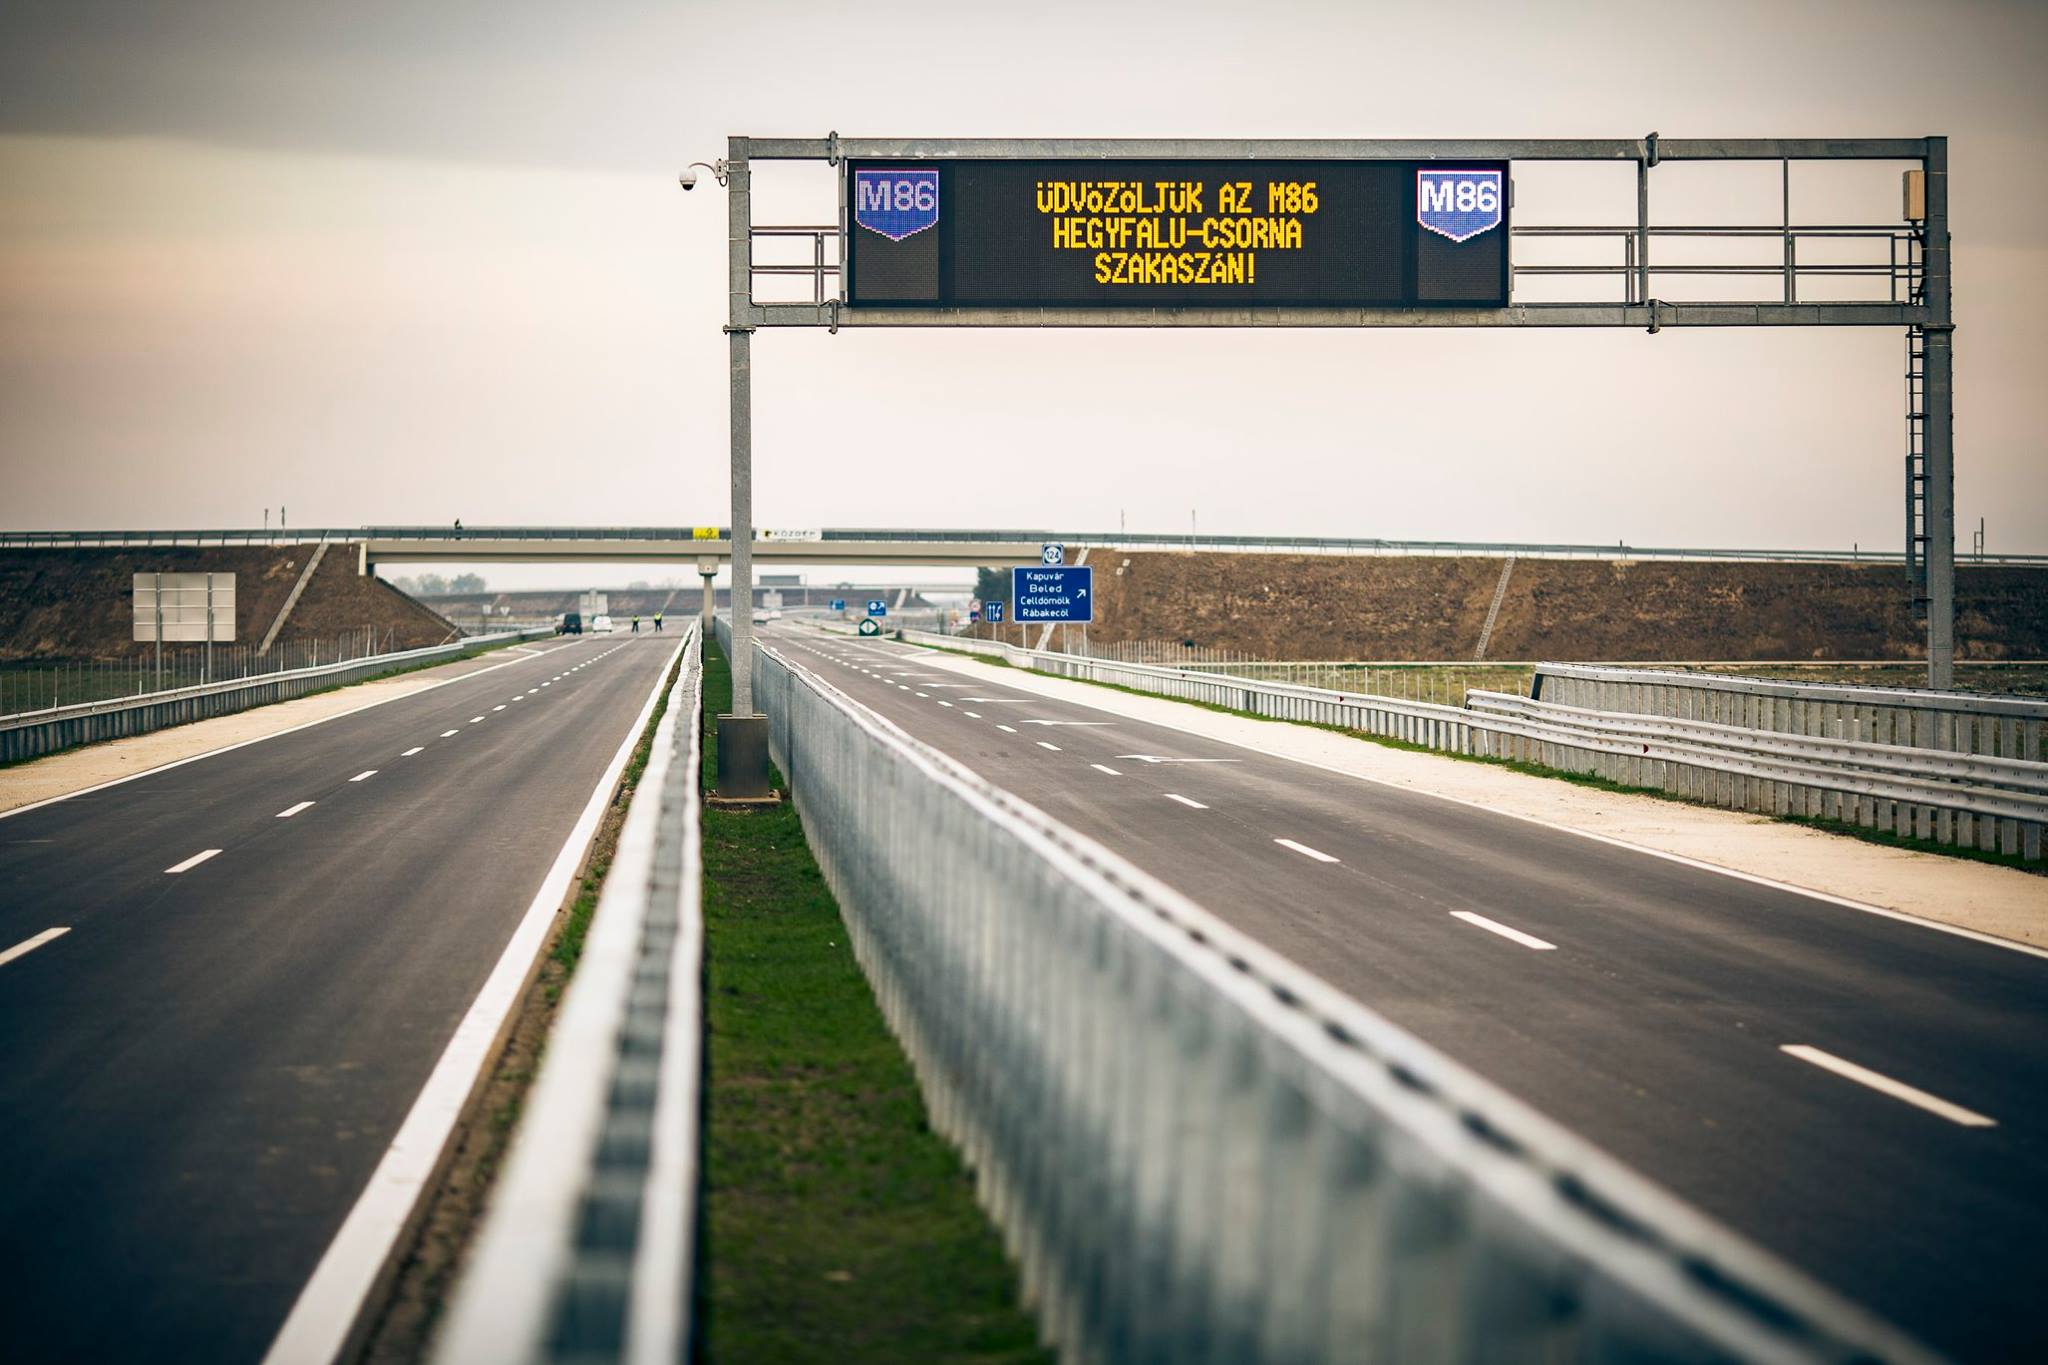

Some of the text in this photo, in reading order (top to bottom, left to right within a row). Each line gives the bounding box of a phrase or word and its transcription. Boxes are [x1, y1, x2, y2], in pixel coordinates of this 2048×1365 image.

[859, 181, 934, 211] M86
[1219, 182, 1252, 213] AZ
[1269, 182, 1318, 213] M86
[1422, 181, 1497, 212] M86
[1054, 218, 1301, 248] HEGYFALU-CSORNA
[1096, 253, 1254, 283] SZAKASZÁN!
[1046, 550, 1060, 560] 124
[1026, 571, 1064, 582] Kapuvár
[1029, 583, 1062, 593] Beled
[1020, 596, 1070, 605] Celldömölk
[1022, 608, 1069, 617] Rábakecöl
